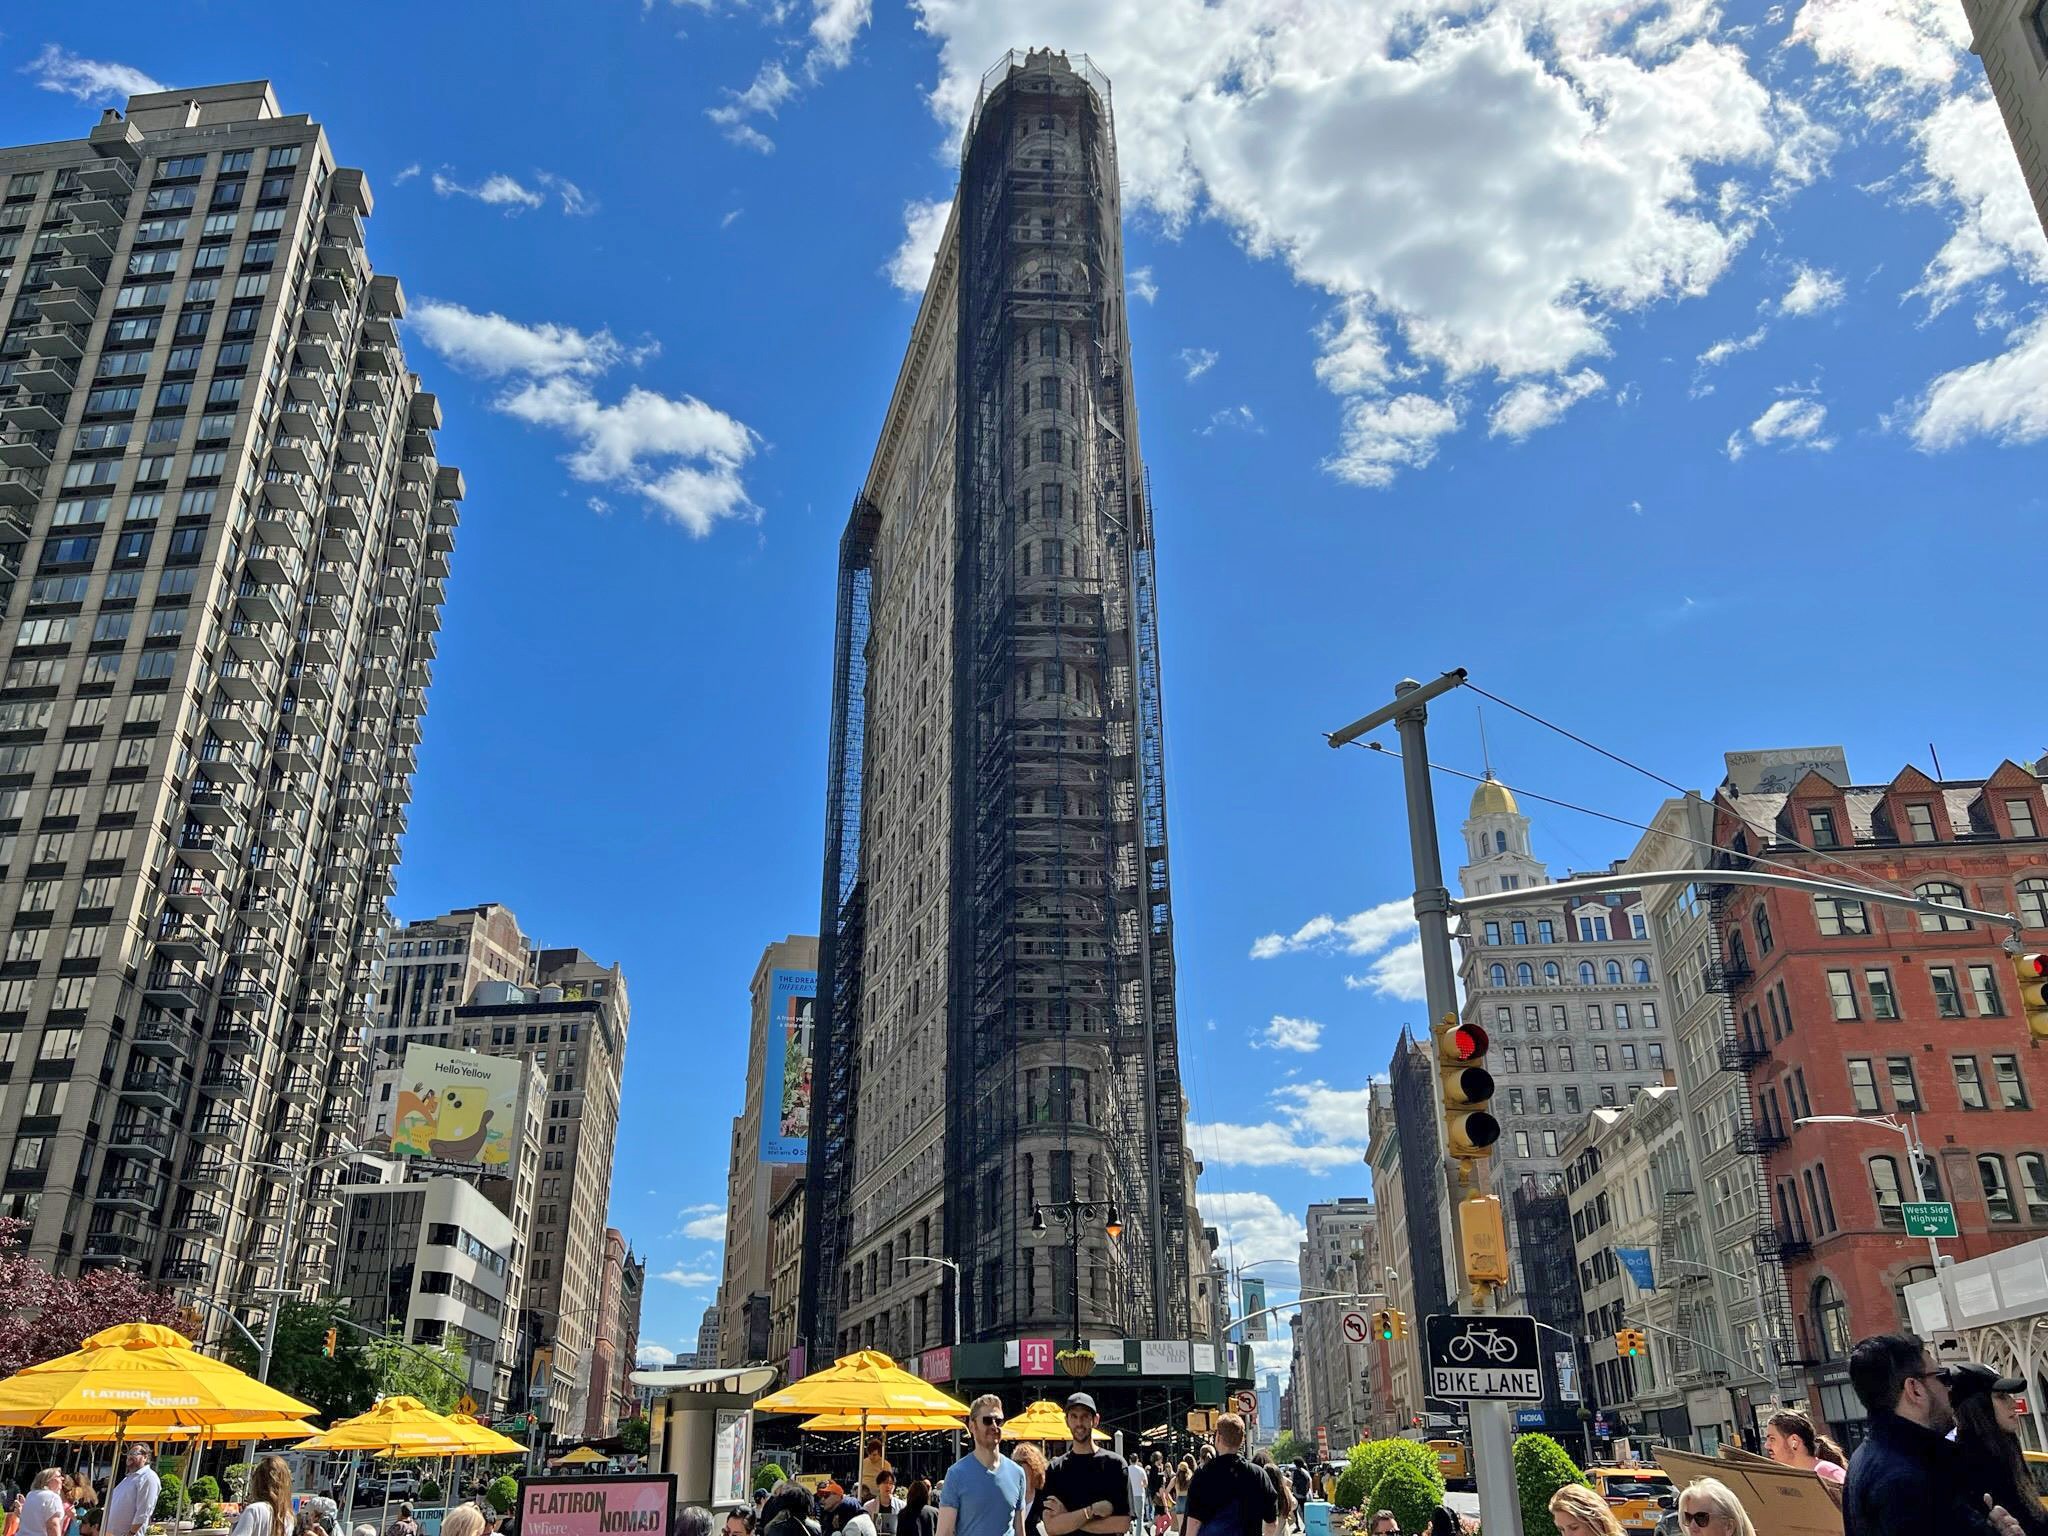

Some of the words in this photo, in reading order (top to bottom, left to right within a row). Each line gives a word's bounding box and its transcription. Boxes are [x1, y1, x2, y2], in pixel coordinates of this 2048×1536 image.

[435, 1063, 460, 1075] Hello
[462, 1066, 491, 1079] Yellow
[1911, 1215, 1948, 1224] Highway
[1027, 1344, 1048, 1371] T
[1437, 1372, 1480, 1392] BIKE
[1487, 1373, 1537, 1393] LANE
[82, 1389, 151, 1399] FLATIRON
[146, 1396, 199, 1406] NOMAD
[1519, 1413, 1543, 1422] HOKA
[529, 1491, 607, 1514] FLATIRON
[412, 1510, 444, 1520] LATIRON
[599, 1509, 660, 1533] NOMAD
[528, 1522, 568, 1536] Where
